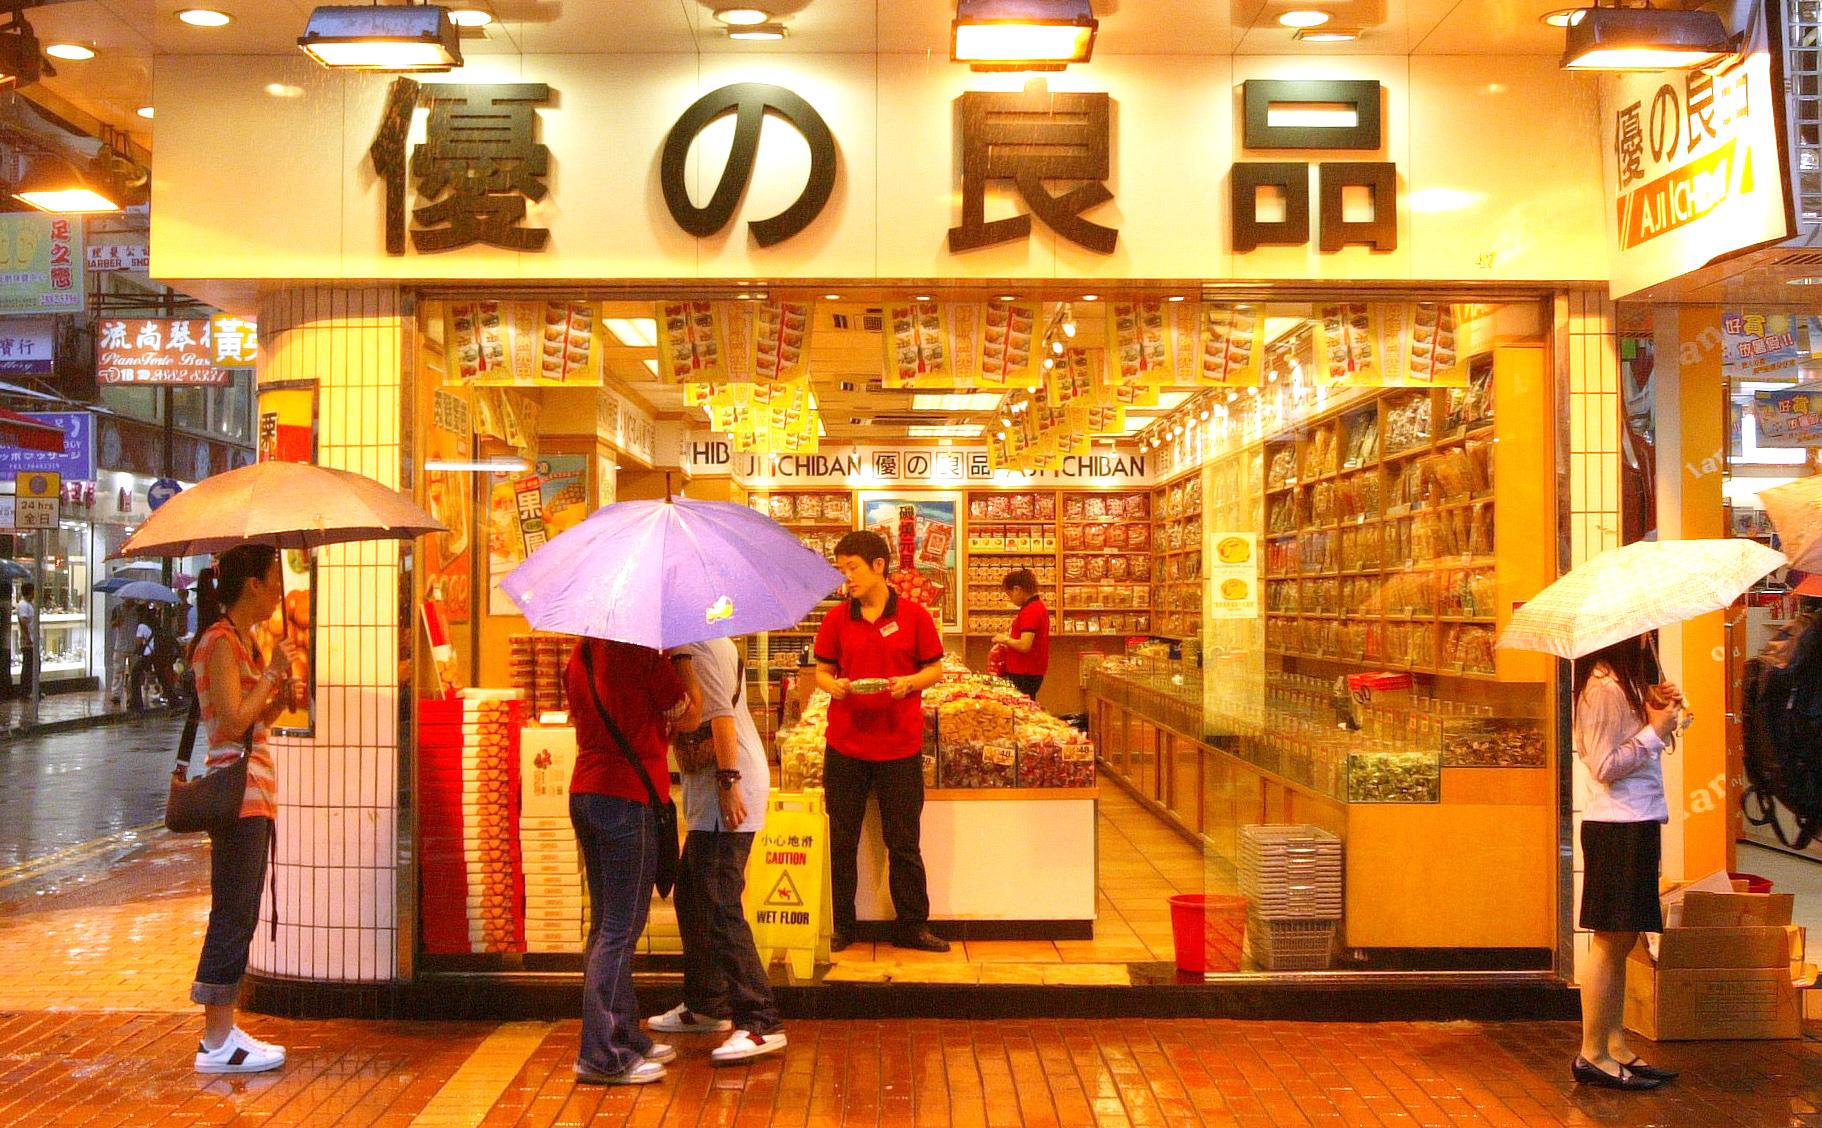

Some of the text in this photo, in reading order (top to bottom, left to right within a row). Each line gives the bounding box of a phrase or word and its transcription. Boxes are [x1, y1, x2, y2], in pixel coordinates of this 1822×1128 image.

[370, 76, 1397, 257] 優の良品
[1641, 191, 1667, 239] AJI
[692, 442, 730, 464] HIB
[875, 454, 990, 476] 優の良品
[21, 501, 54, 510] 24 hrs
[24, 513, 49, 525] 全日
[761, 834, 813, 847] 小心地滑
[765, 852, 807, 865] CAUTION
[757, 911, 810, 925] WET FLOOR
